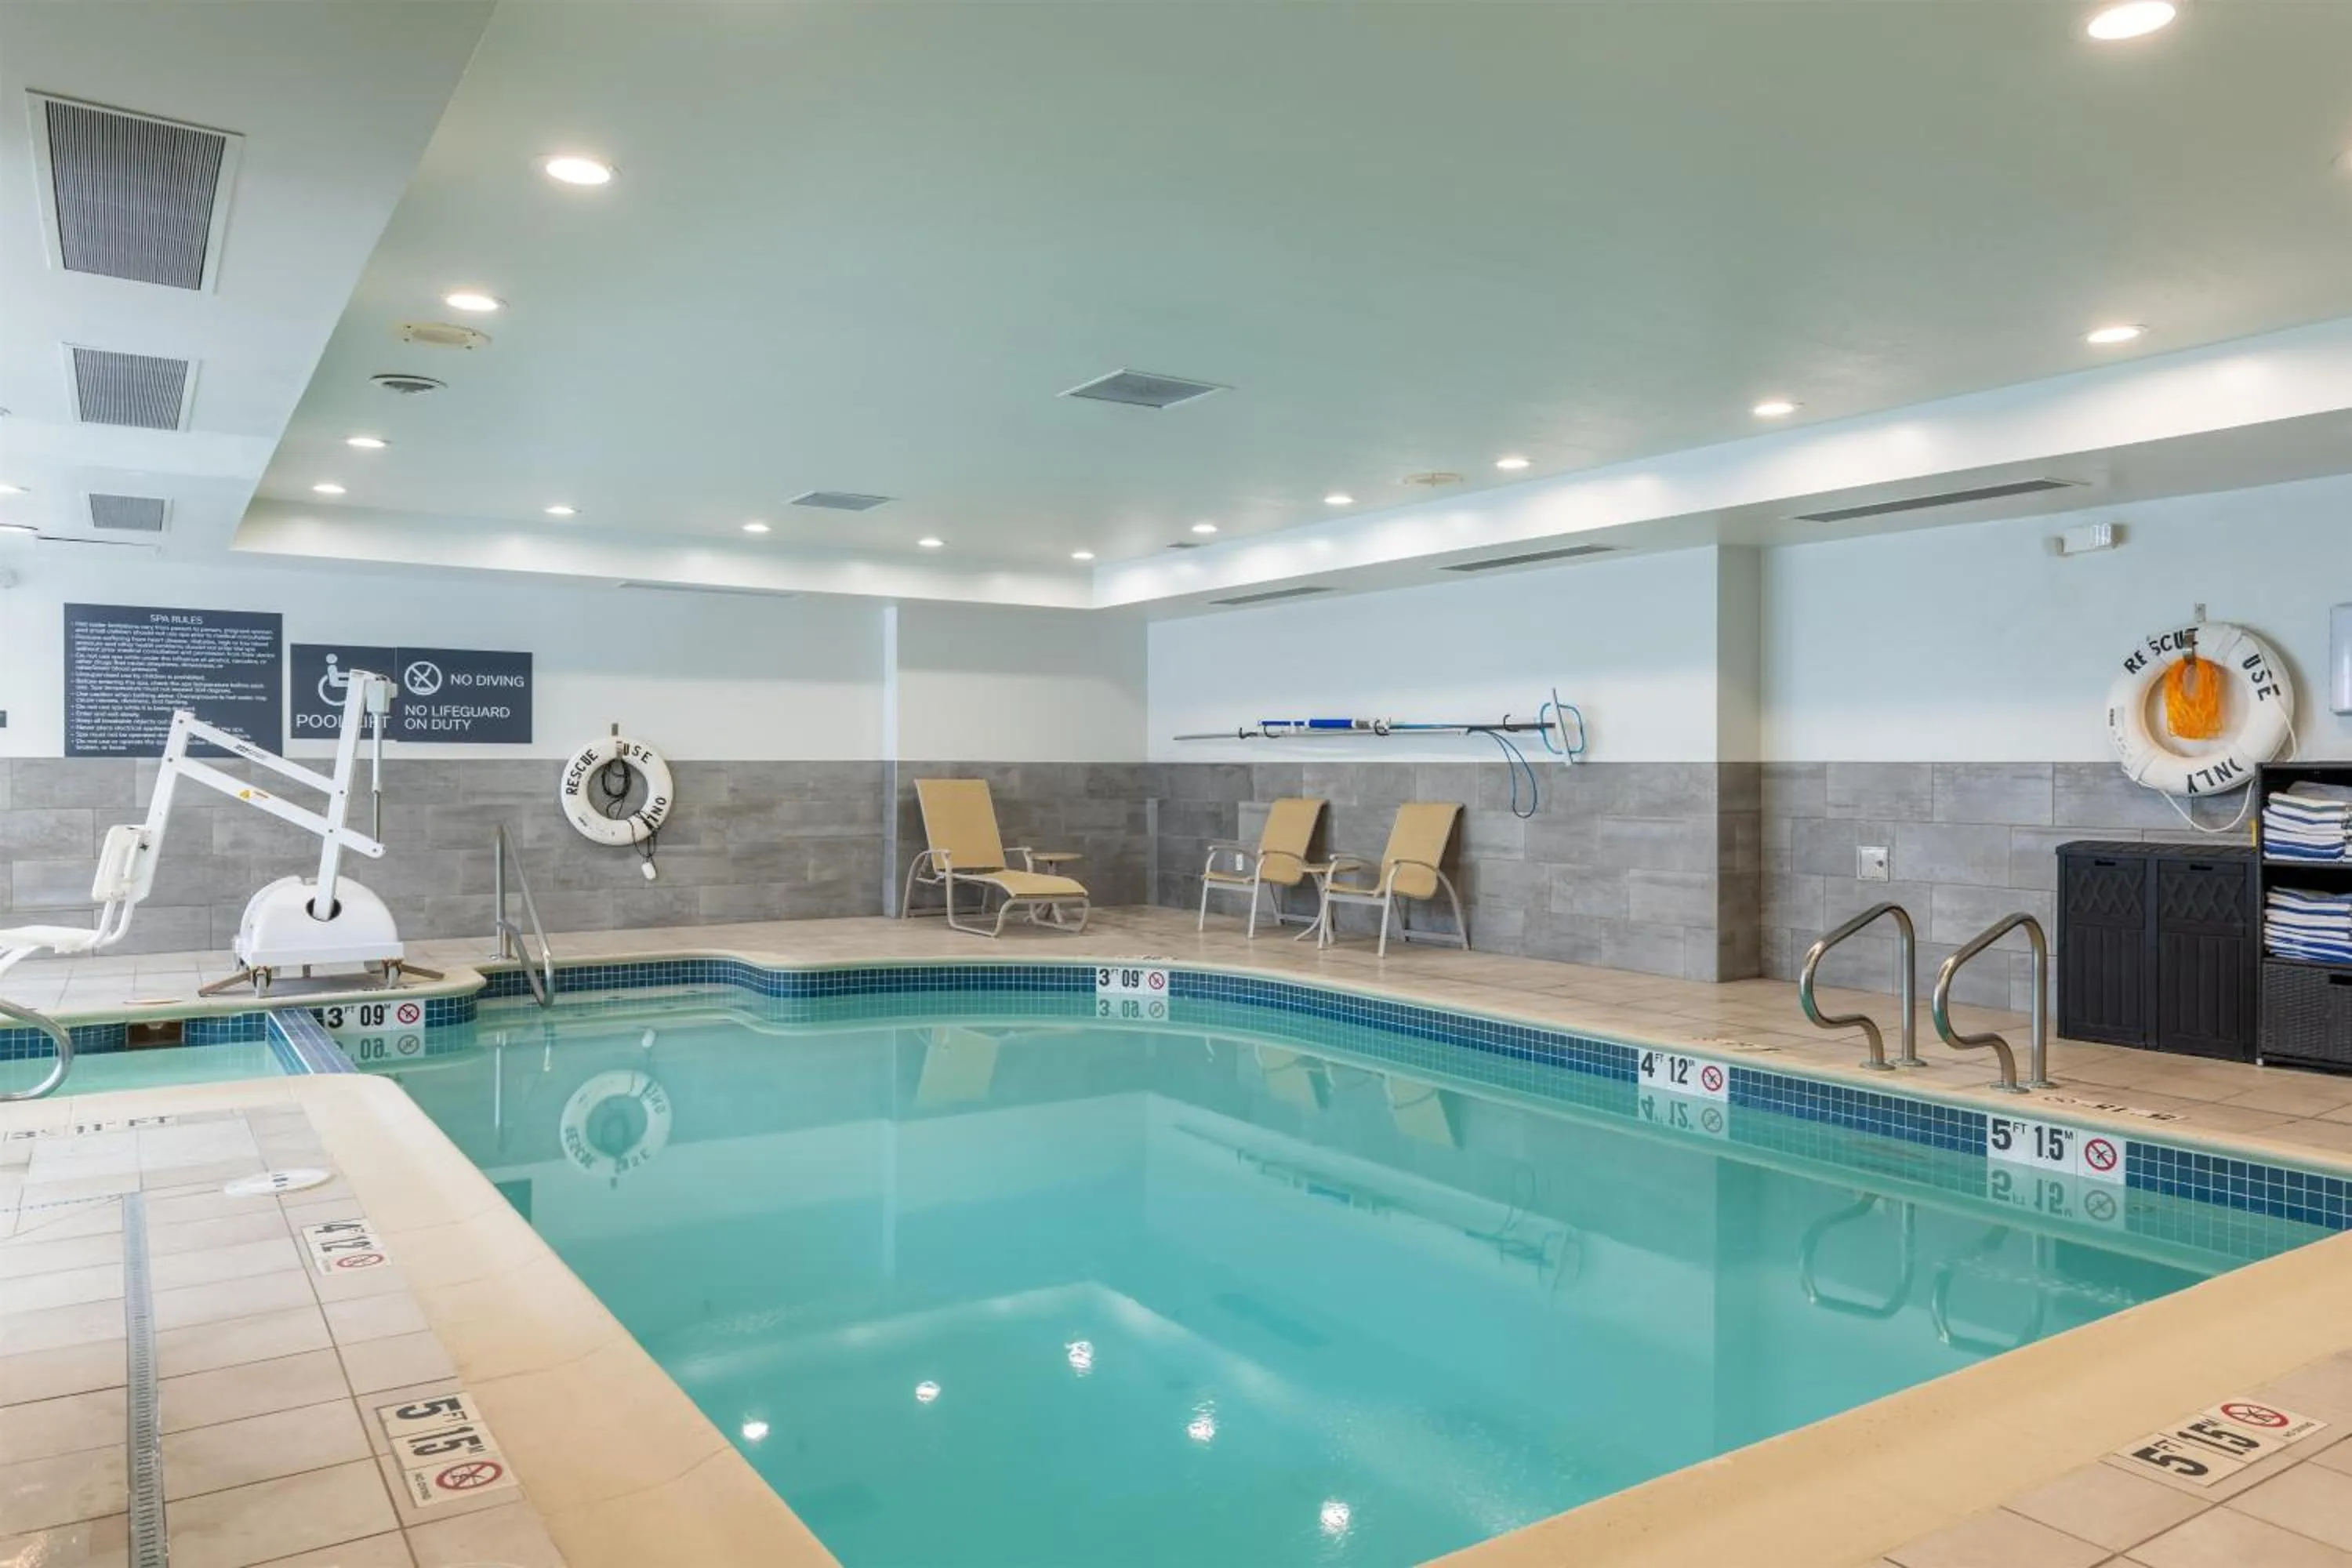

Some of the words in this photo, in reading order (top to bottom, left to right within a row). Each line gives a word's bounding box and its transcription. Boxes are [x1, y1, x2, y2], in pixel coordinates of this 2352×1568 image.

[171, 615, 202, 624] RULES
[450, 673, 472, 686] NO
[477, 674, 524, 688] DIVING
[2242, 653, 2281, 701] USE
[358, 713, 392, 728] IFT
[405, 705, 427, 716] NO
[432, 706, 510, 719] LIFEGUARD
[404, 718, 426, 730] ON
[432, 719, 471, 731] DUTY
[565, 748, 598, 796] RESCUE
[623, 742, 652, 764] USE
[1098, 968, 1110, 987] 3
[327, 1007, 344, 1029] 3
[1641, 1051, 1655, 1079] 4
[1991, 1117, 2012, 1150] 5
[2013, 1122, 2027, 1135] FT
[2064, 1130, 2074, 1140] M
[396, 1397, 463, 1420] 5
[442, 1410, 468, 1423] FT
[2152, 1439, 2183, 1453] FT
[2131, 1446, 2209, 1476] 5
